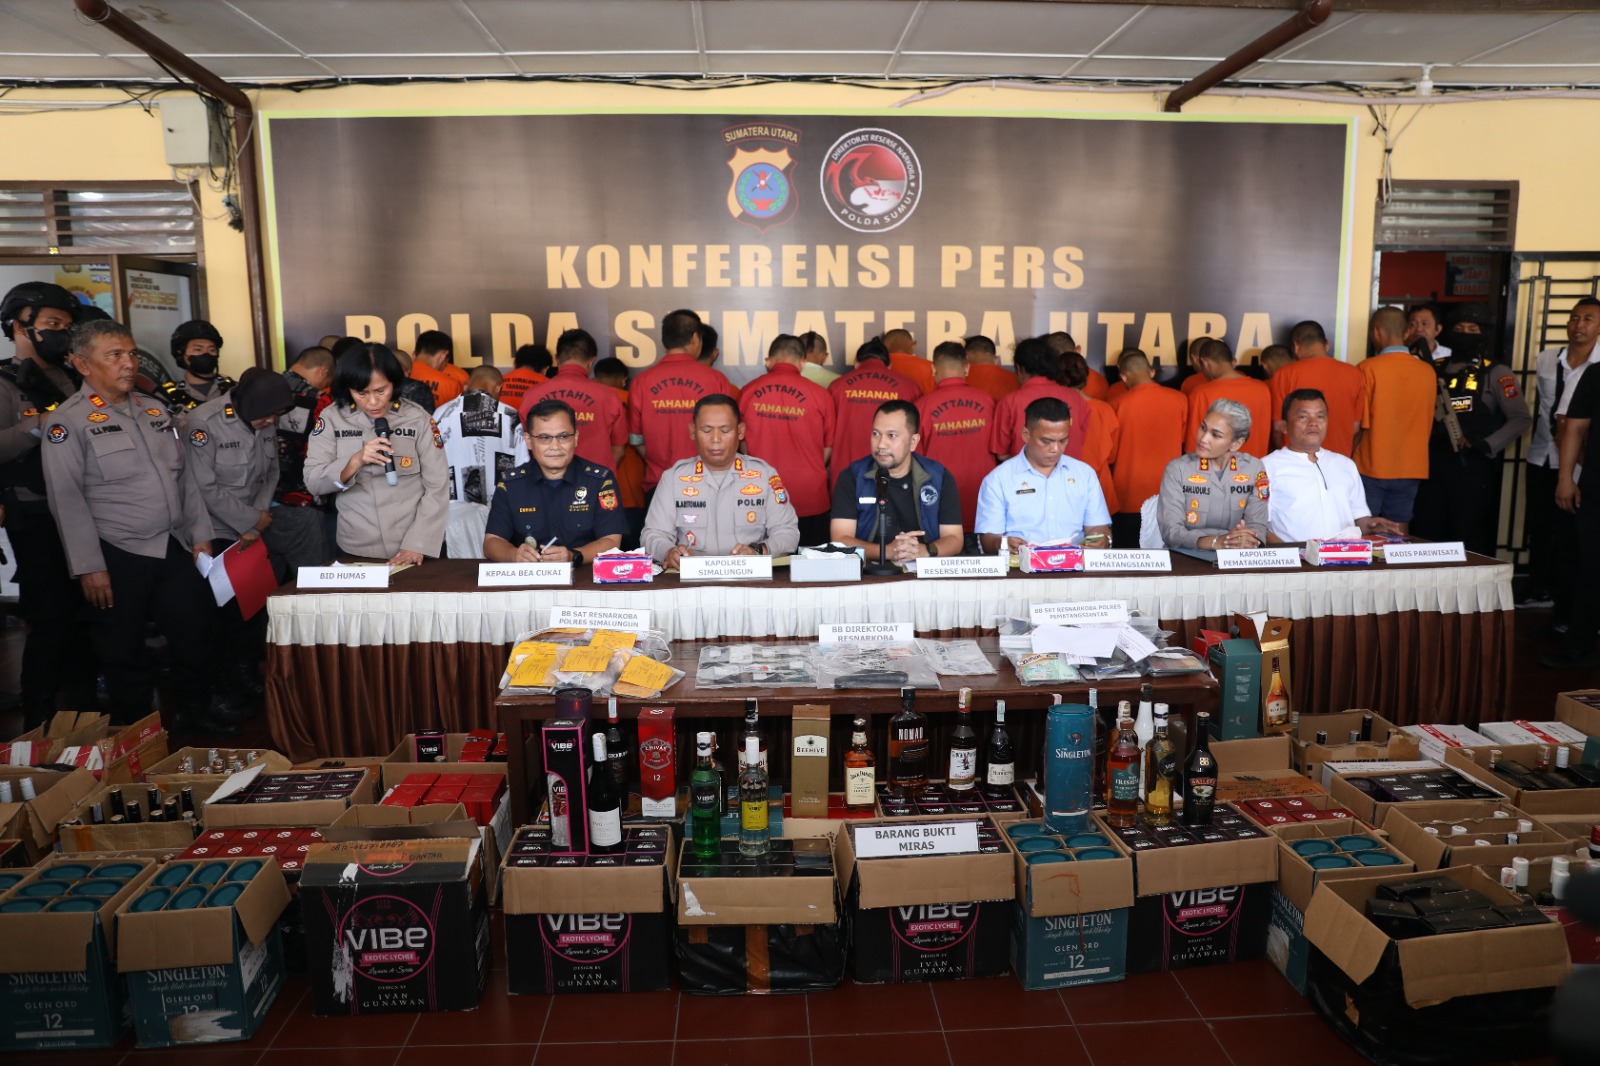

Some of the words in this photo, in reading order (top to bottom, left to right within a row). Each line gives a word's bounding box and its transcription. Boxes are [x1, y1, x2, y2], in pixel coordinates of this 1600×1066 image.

[724, 126, 770, 142] SUMATERA
[770, 128, 798, 142] UTARA
[832, 134, 870, 160] DIREKTORAT
[870, 134, 897, 149] RESERSE
[896, 146, 915, 181] NARKOBA
[840, 208, 880, 226] POLDA
[883, 190, 915, 224] SUMUT
[546, 244, 914, 289] KONFERENSI
[940, 244, 1084, 289] PERS
[614, 310, 1016, 369] SMATRA
[846, 372, 899, 388] DITTAHTI
[650, 378, 704, 396] DITTAHTI
[754, 384, 806, 404] DITTAHTI
[845, 390, 898, 400] TAHANAN
[652, 400, 698, 409] TAHANA
[753, 402, 806, 416] TAHANAN
[930, 399, 985, 418] DITTAHTI
[933, 418, 986, 431] TAHANAN
[1230, 485, 1254, 494] POLRI
[1239, 550, 1277, 558] KAPOLRES
[1413, 549, 1460, 557] PARIWISATA
[1223, 558, 1296, 566] PEMATANGSIANTAR
[320, 572, 336, 580] BID
[336, 572, 366, 580] HUMAS
[1050, 612, 1109, 620] PEMATANGSIANTAR
[589, 620, 639, 628] SIMALUNGUN
[875, 828, 920, 839] BARANG
[924, 826, 956, 837] BUKTI
[899, 841, 935, 851] MIRAS
[1181, 908, 1202, 917] EXOTIC
[1203, 907, 1224, 915] LYCHEE
[910, 923, 934, 931] EXOTIC
[1045, 912, 1112, 931] SINGLETON
[1054, 942, 1078, 953] GLEN
[1084, 941, 1099, 950] ORD
[364, 954, 389, 962] EXOTIC
[390, 953, 414, 961] LYCHEE
[1172, 950, 1226, 960] GUNAWAN
[1068, 954, 1085, 968] 12
[147, 965, 226, 984] SINGLETON
[904, 966, 962, 975] GUNAWAN
[8, 972, 87, 986] SINGLETON
[378, 993, 408, 1001] IVAN
[24, 1002, 52, 1010] GLEN
[363, 998, 425, 1008] GUNAWAN
[43, 1013, 63, 1028] 12
